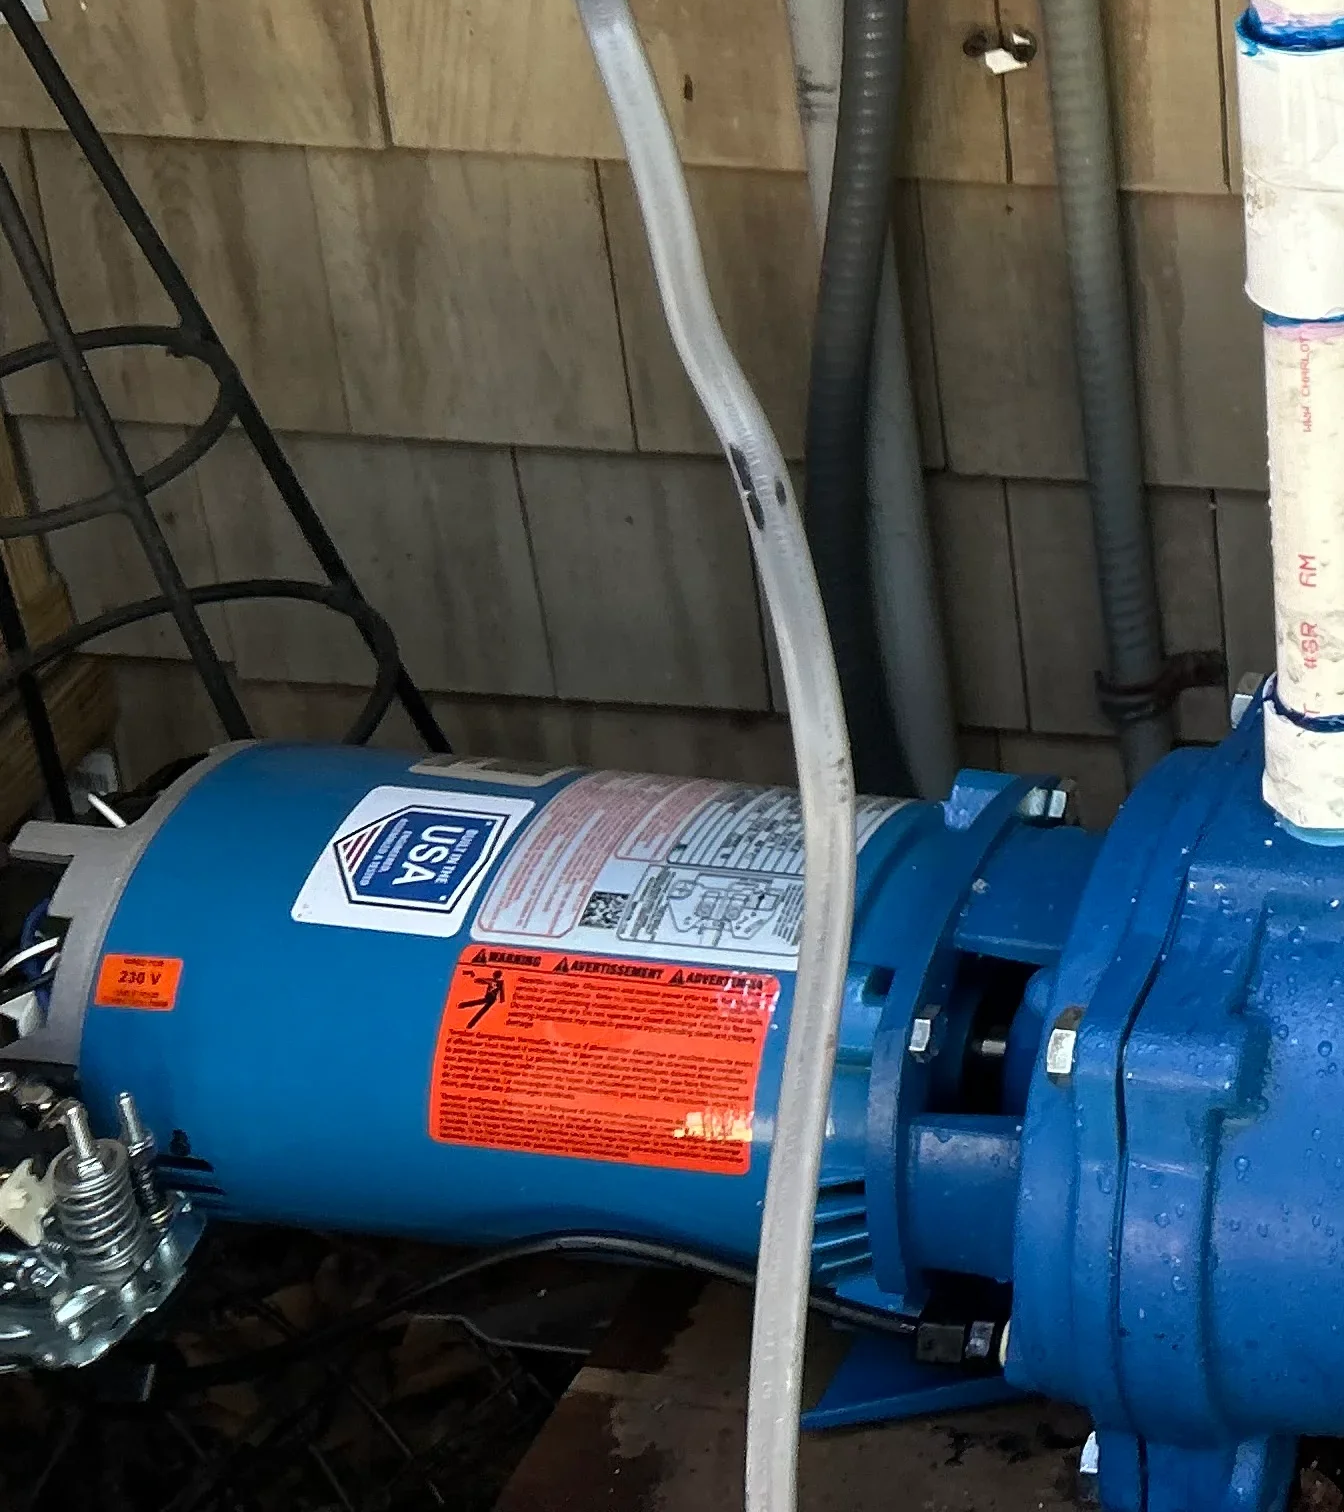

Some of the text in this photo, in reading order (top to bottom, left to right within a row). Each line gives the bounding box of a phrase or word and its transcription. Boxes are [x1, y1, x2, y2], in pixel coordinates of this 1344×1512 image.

[391, 824, 466, 887] USA
[117, 970, 162, 986] 230 V
[570, 959, 665, 980] AVERTISSEMENT
